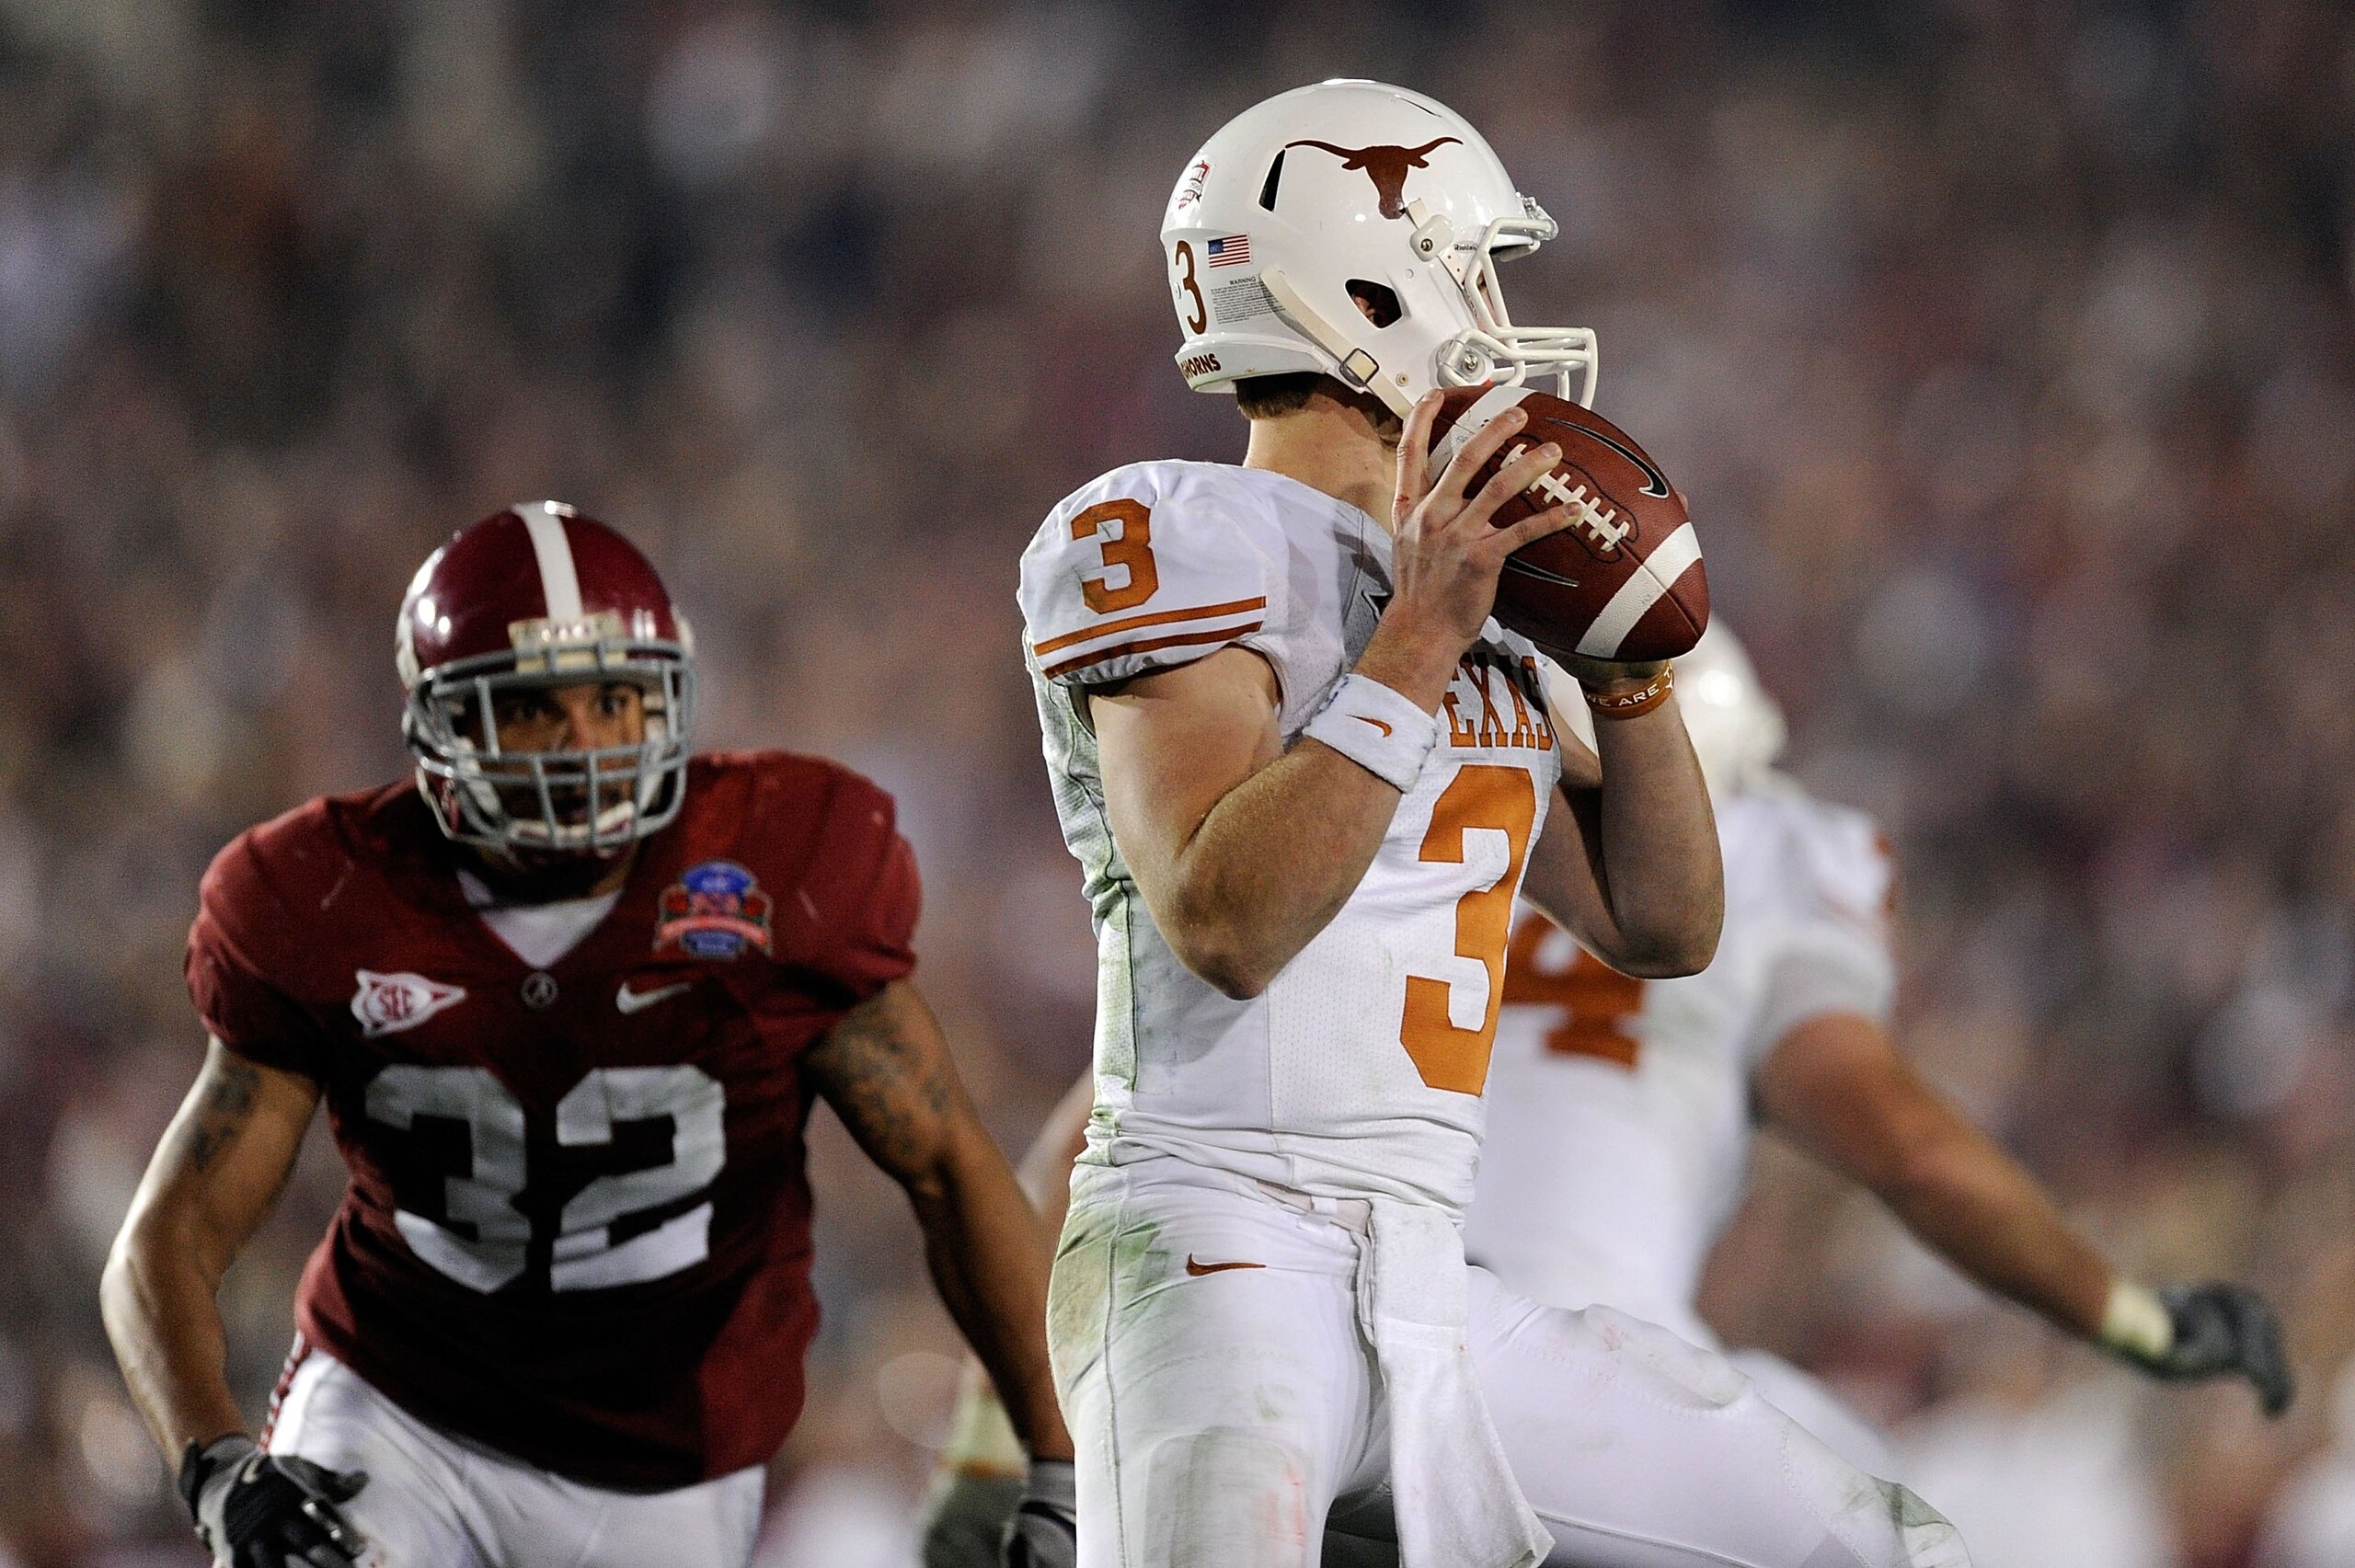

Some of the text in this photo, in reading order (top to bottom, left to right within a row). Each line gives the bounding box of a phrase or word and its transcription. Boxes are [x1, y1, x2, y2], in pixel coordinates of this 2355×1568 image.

[1176, 240, 1207, 335] 3
[1229, 276, 1257, 285] WARNING
[1071, 498, 1159, 615] 3
[1432, 652, 1553, 751] EXAS
[1618, 683, 1660, 707] ARE
[1400, 764, 1536, 1097] 3
[364, 1063, 727, 1294] 32
